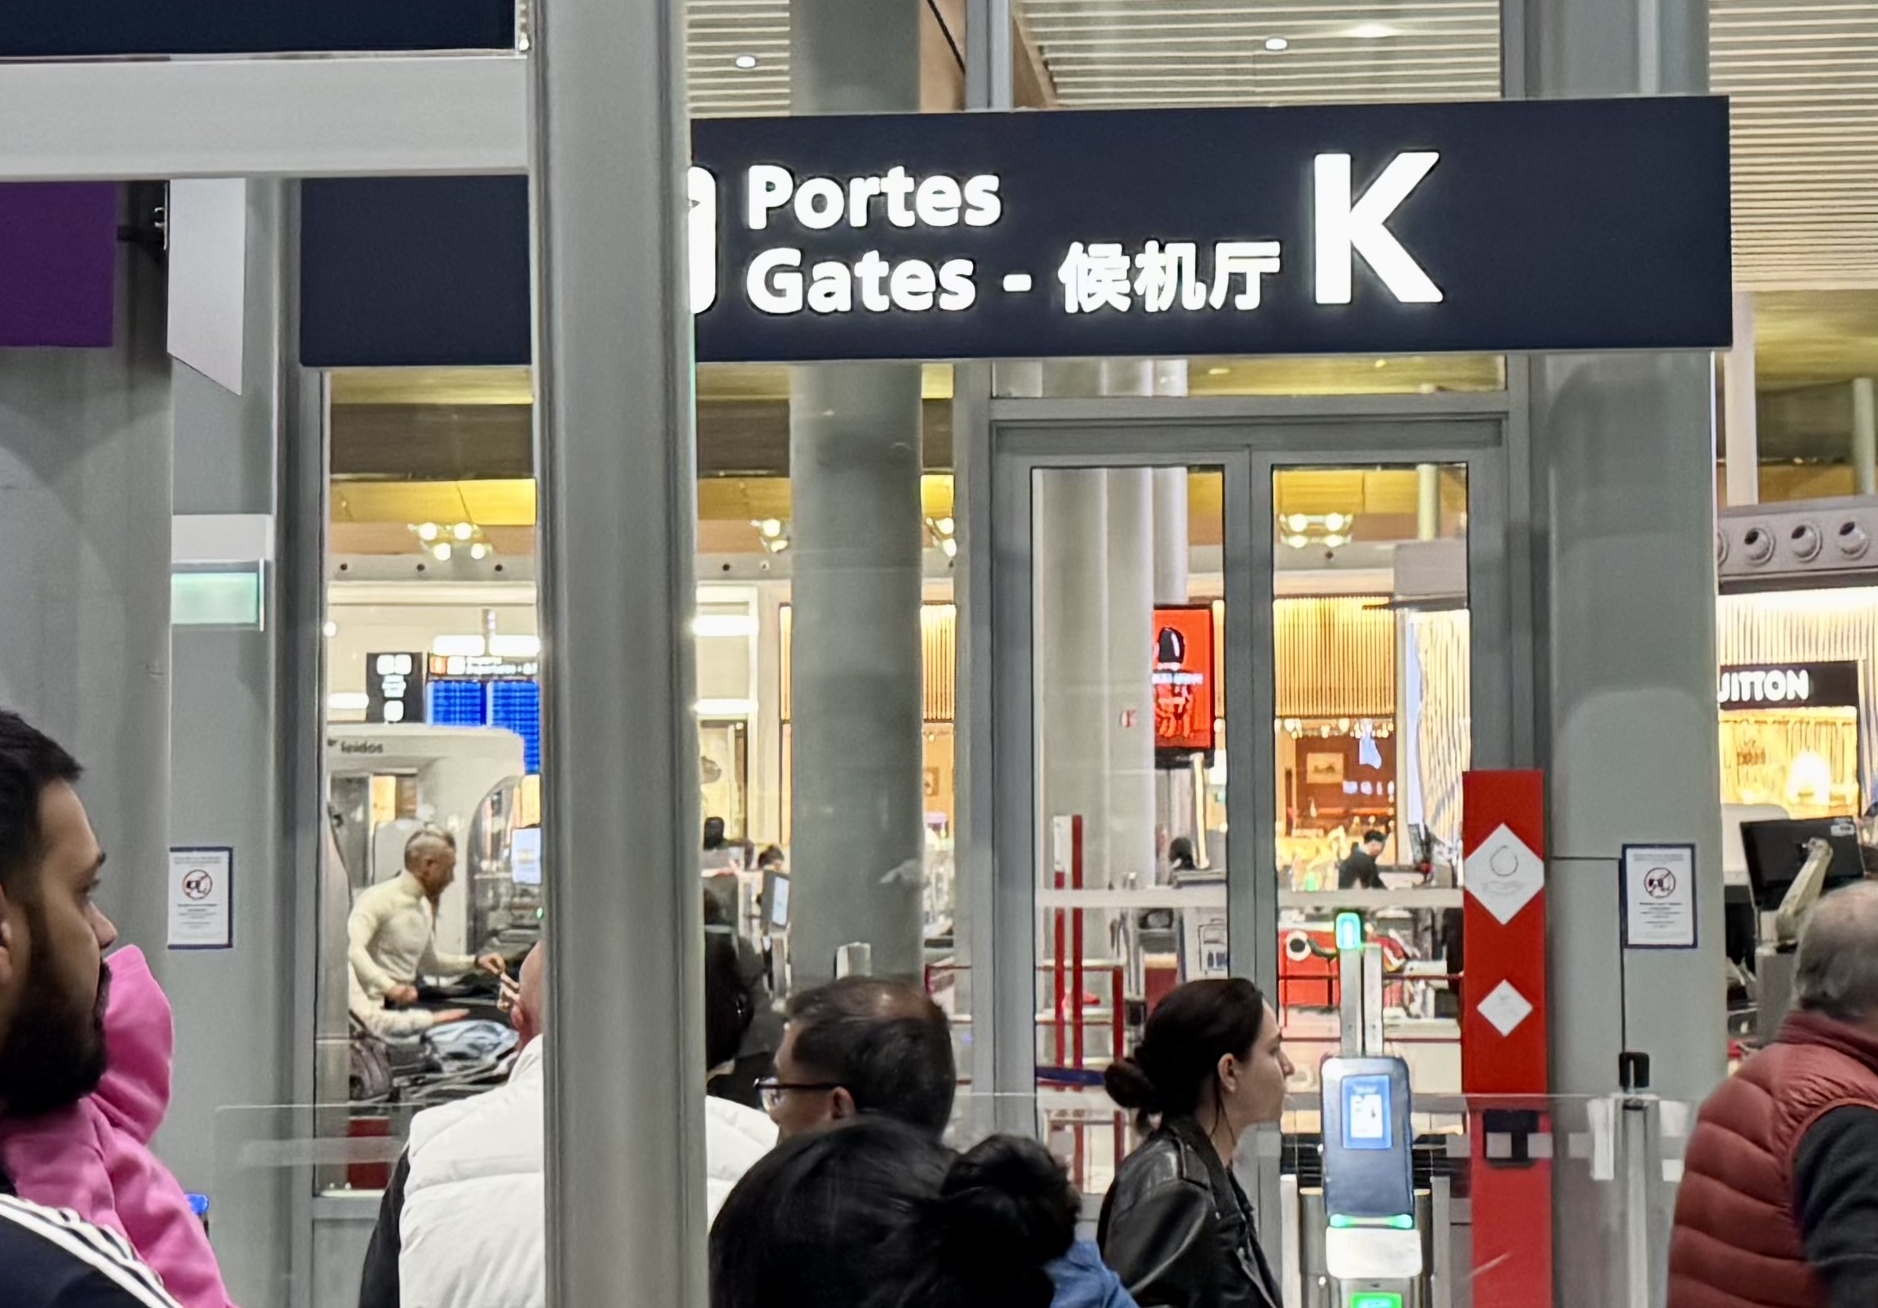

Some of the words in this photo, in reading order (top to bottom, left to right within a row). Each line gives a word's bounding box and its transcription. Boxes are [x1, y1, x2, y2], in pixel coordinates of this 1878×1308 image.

[746, 163, 1003, 230] Portes
[1314, 149, 1444, 305] K
[745, 245, 977, 316] Gates
[1057, 239, 1283, 316] 候机厅
[1716, 669, 1811, 703] UITTON
